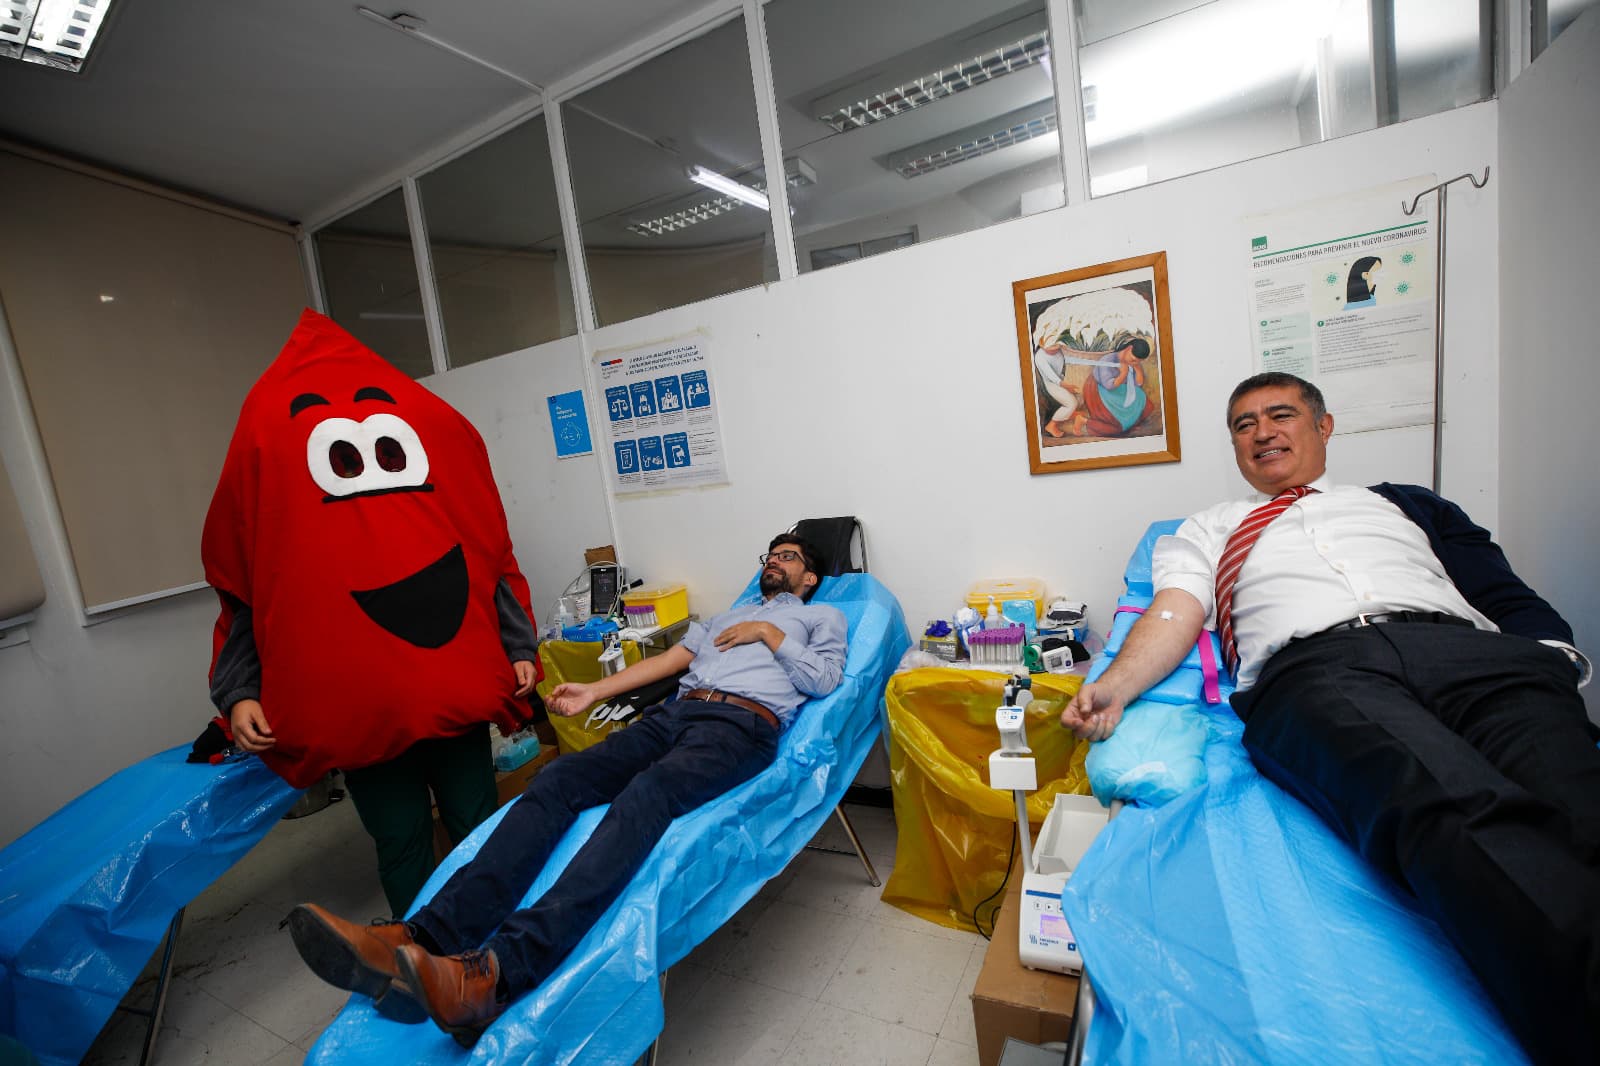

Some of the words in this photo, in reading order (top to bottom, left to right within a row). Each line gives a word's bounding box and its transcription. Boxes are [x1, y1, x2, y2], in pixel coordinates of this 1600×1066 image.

[1253, 252, 1307, 269] RECOMENDACIONES
[1307, 249, 1323, 257] PARA
[1324, 242, 1352, 253] PREVENIR
[1361, 236, 1382, 246] NUEVO
[1383, 227, 1427, 241] CORONAVIRUS
